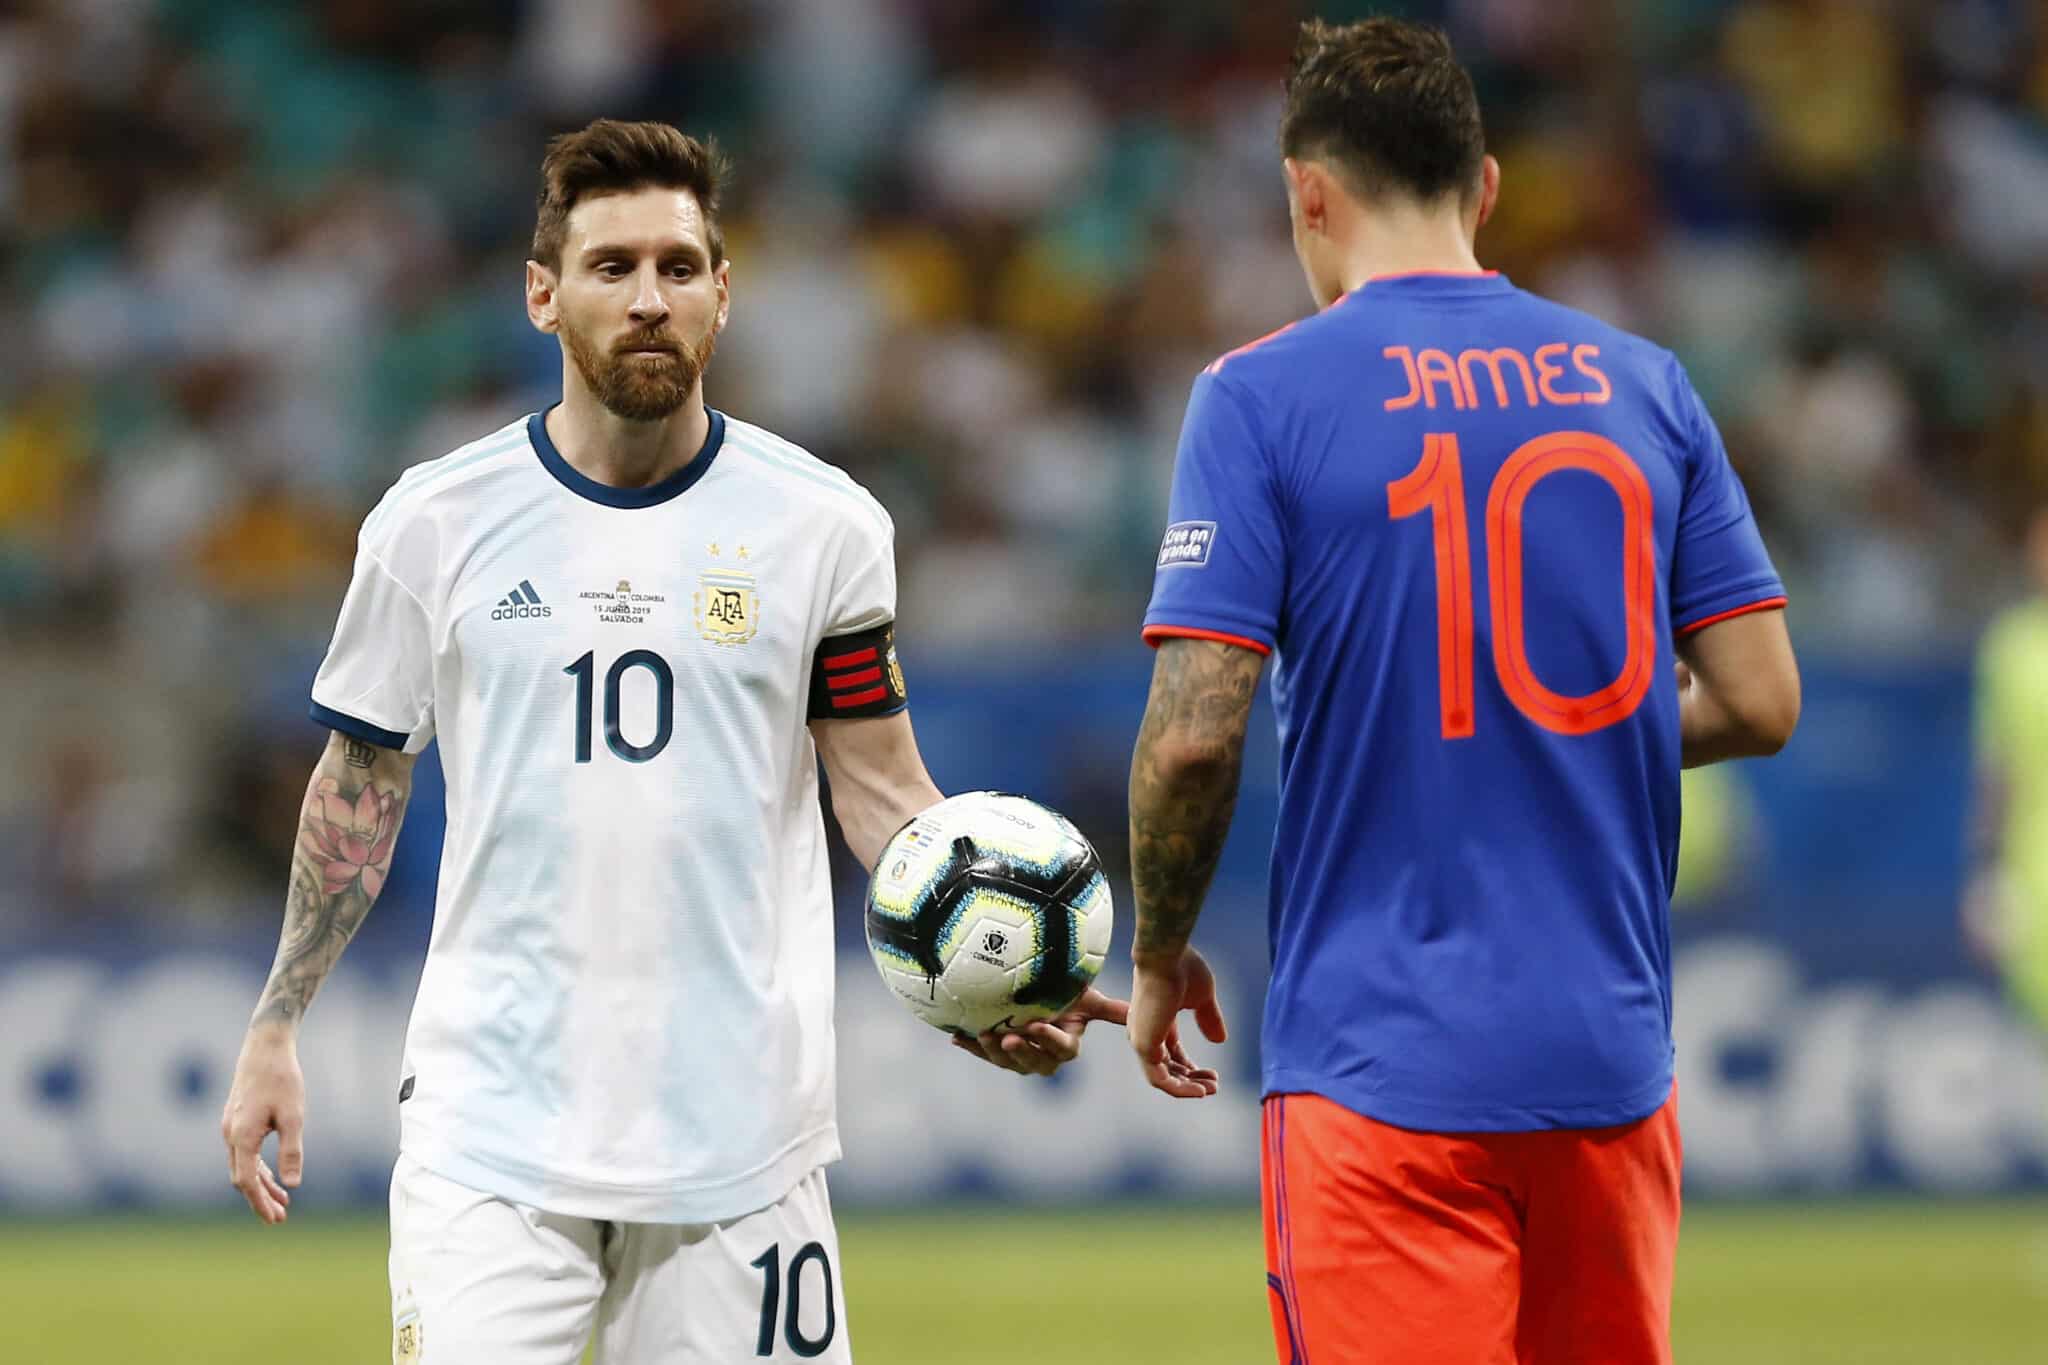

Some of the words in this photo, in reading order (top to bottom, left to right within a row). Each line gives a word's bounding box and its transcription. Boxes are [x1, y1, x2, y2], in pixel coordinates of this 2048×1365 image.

[1383, 343, 1612, 411] JAMES
[1190, 529, 1209, 543] en
[1160, 544, 1202, 564] grande
[1386, 430, 1656, 740] 10
[579, 592, 615, 600] ARGENTINA
[630, 594, 665, 602] COLOMBIA
[708, 588, 745, 625] AFA
[491, 603, 552, 621] adidas
[593, 604, 603, 613] 15
[632, 606, 651, 615] 2019
[600, 614, 644, 624] SALVADOR
[563, 649, 673, 763] 10
[750, 1241, 836, 1358] 10
